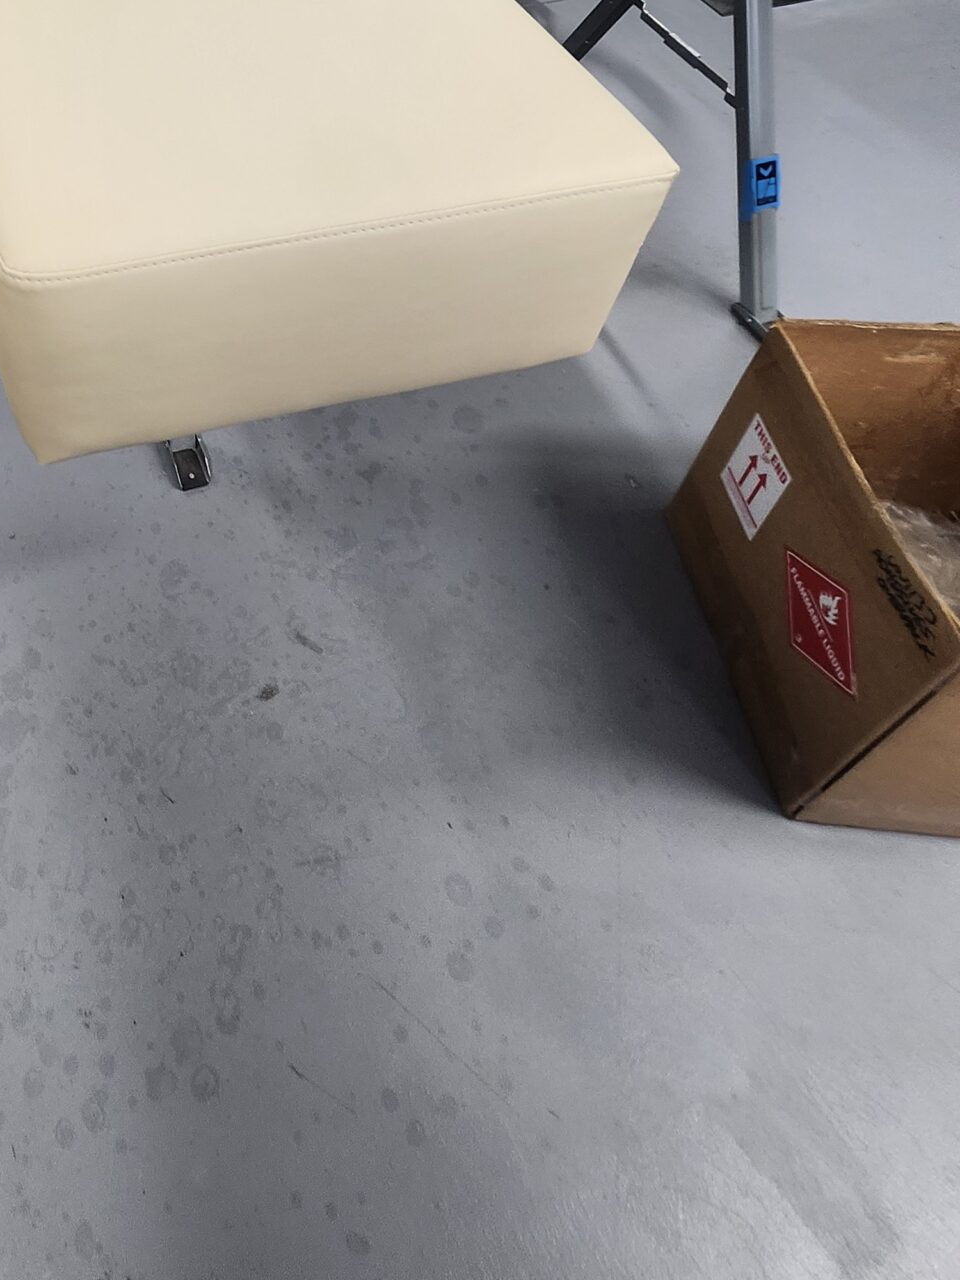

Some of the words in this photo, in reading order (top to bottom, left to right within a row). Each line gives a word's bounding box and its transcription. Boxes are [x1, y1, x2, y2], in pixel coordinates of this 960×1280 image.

[754, 421, 772, 453] THIS
[770, 454, 788, 485] END
[790, 567, 825, 638] FLAMMABLE
[822, 638, 846, 681] LIQUID
